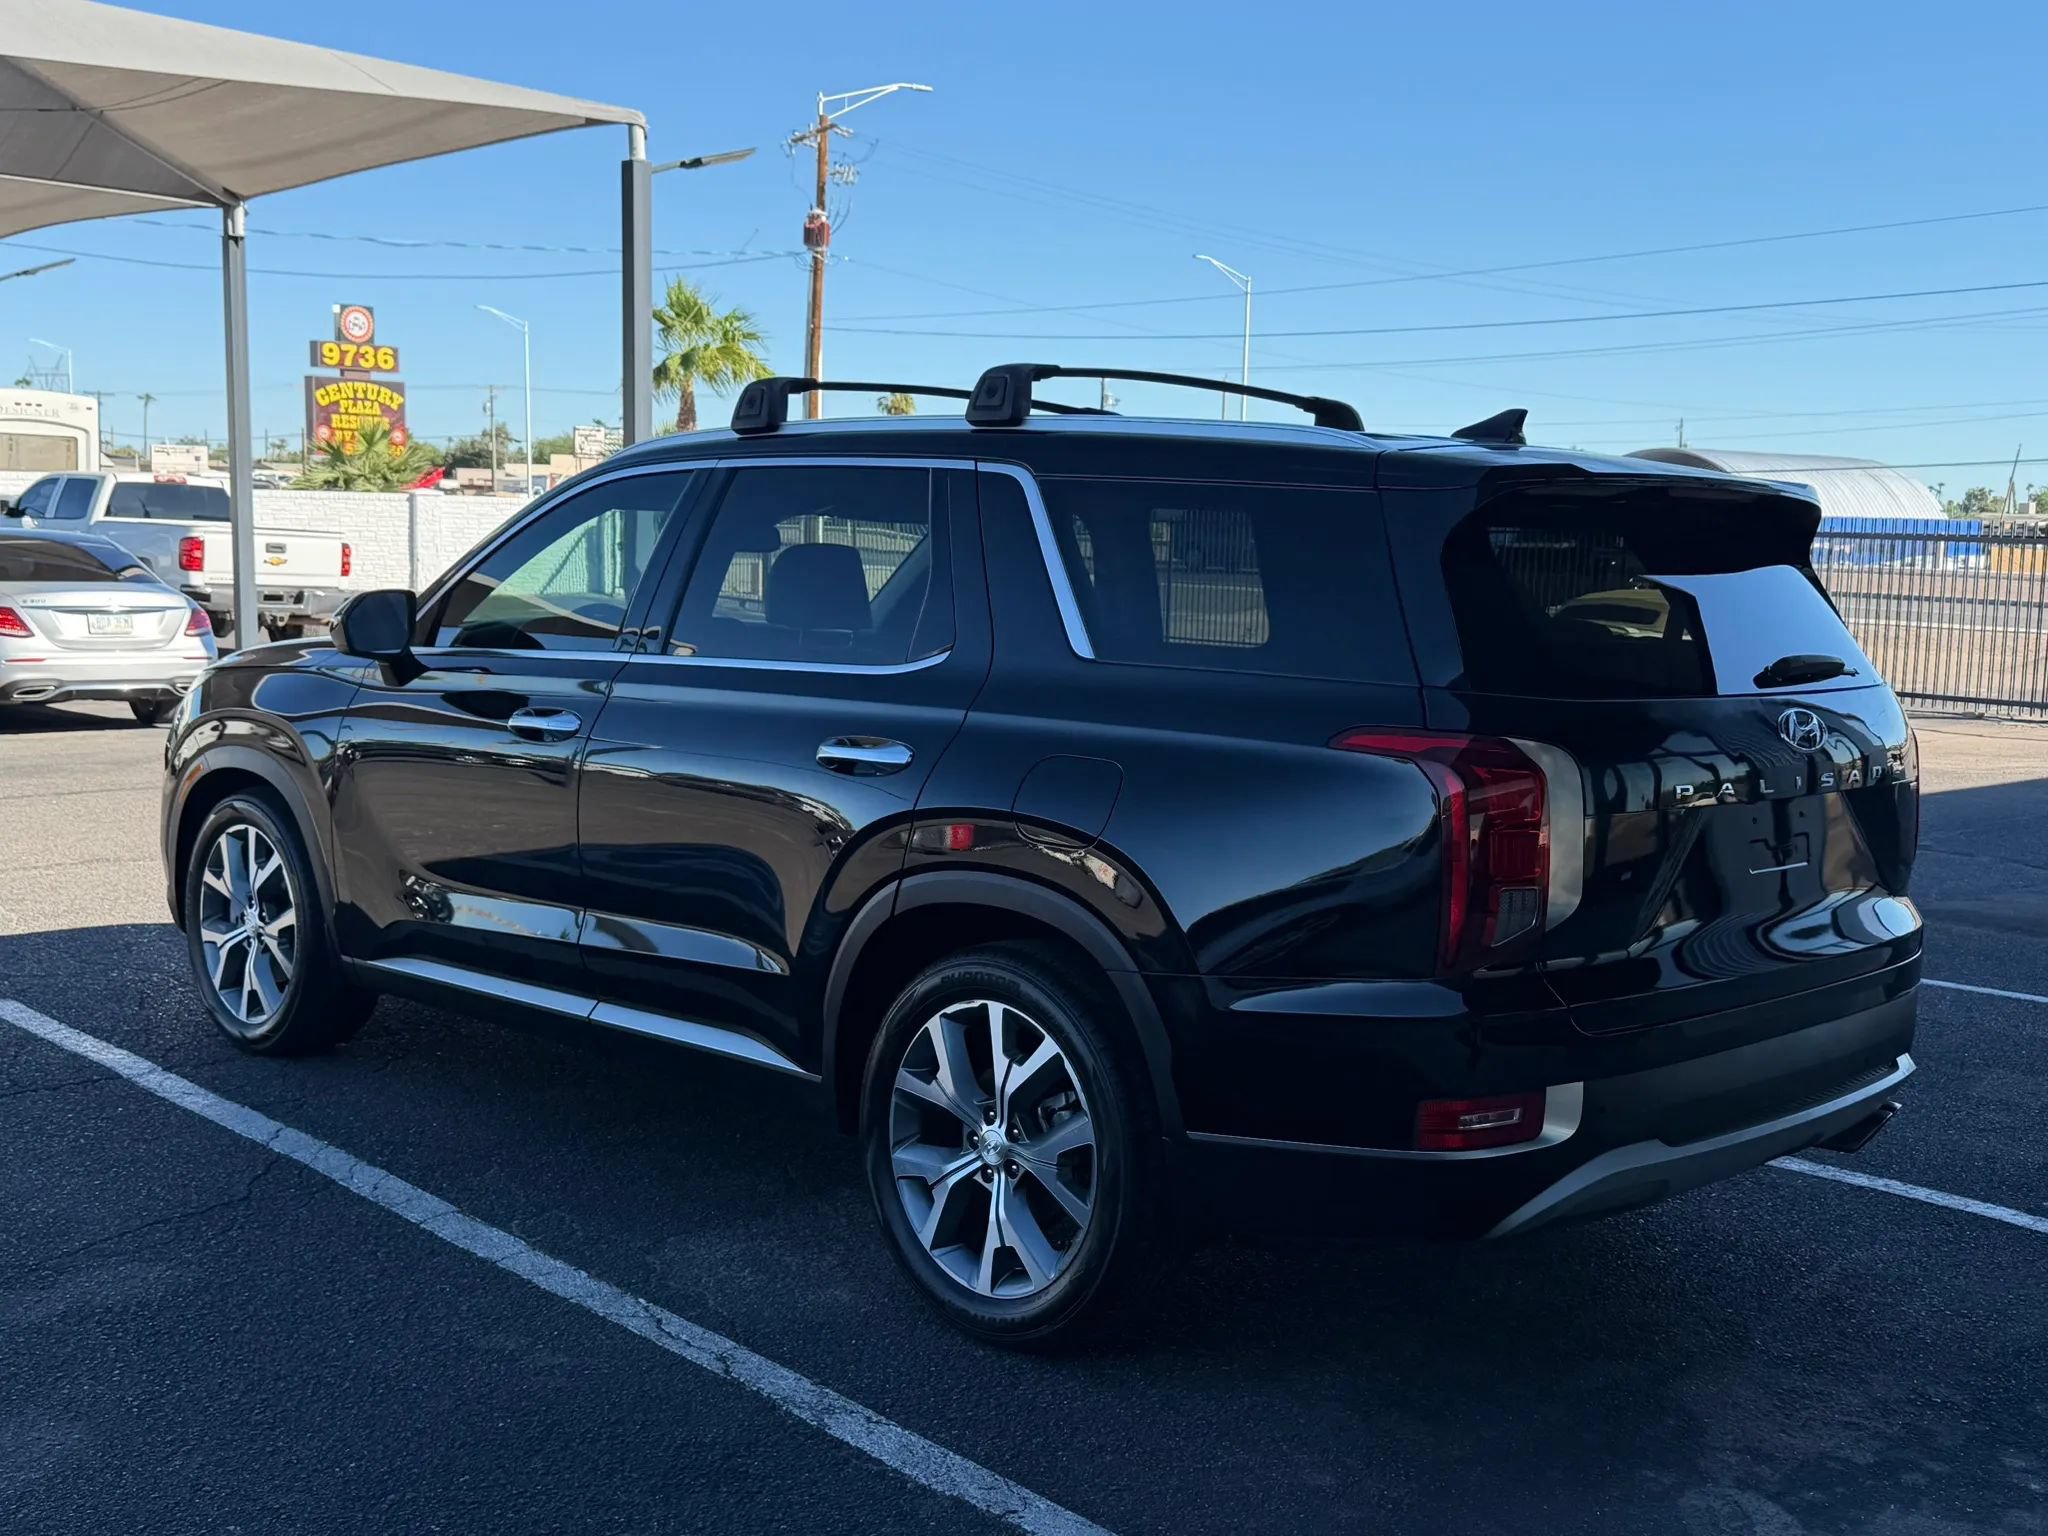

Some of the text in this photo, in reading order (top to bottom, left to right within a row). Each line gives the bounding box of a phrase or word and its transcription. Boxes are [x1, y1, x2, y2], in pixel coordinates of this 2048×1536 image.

[322, 342, 395, 370] 9736
[315, 381, 404, 411] CENTURY
[339, 400, 381, 415] PLAZA
